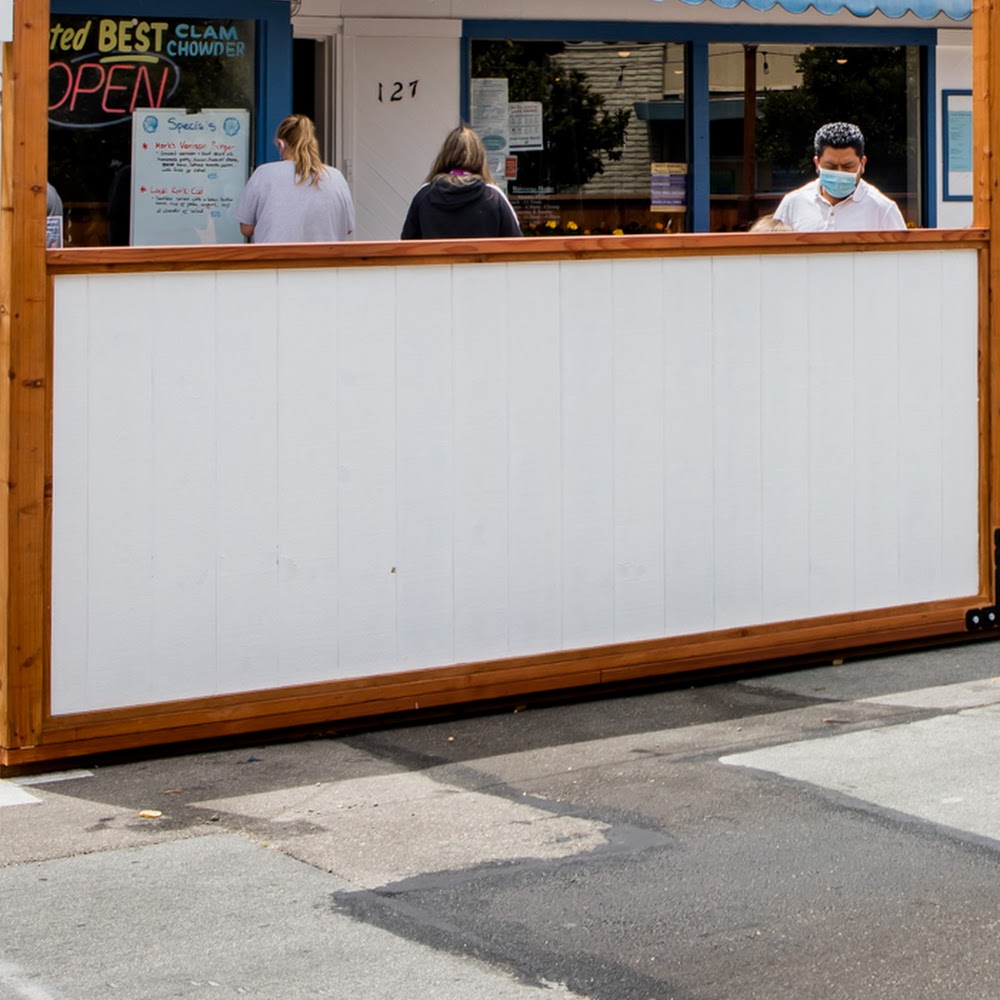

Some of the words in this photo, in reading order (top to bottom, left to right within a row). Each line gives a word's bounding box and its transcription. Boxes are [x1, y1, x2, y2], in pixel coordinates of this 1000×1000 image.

[98, 19, 169, 53] BEST
[175, 23, 239, 40] CLAM
[166, 39, 246, 58] CHOWDER
[48, 61, 169, 113] OPEN
[378, 79, 419, 103] 127
